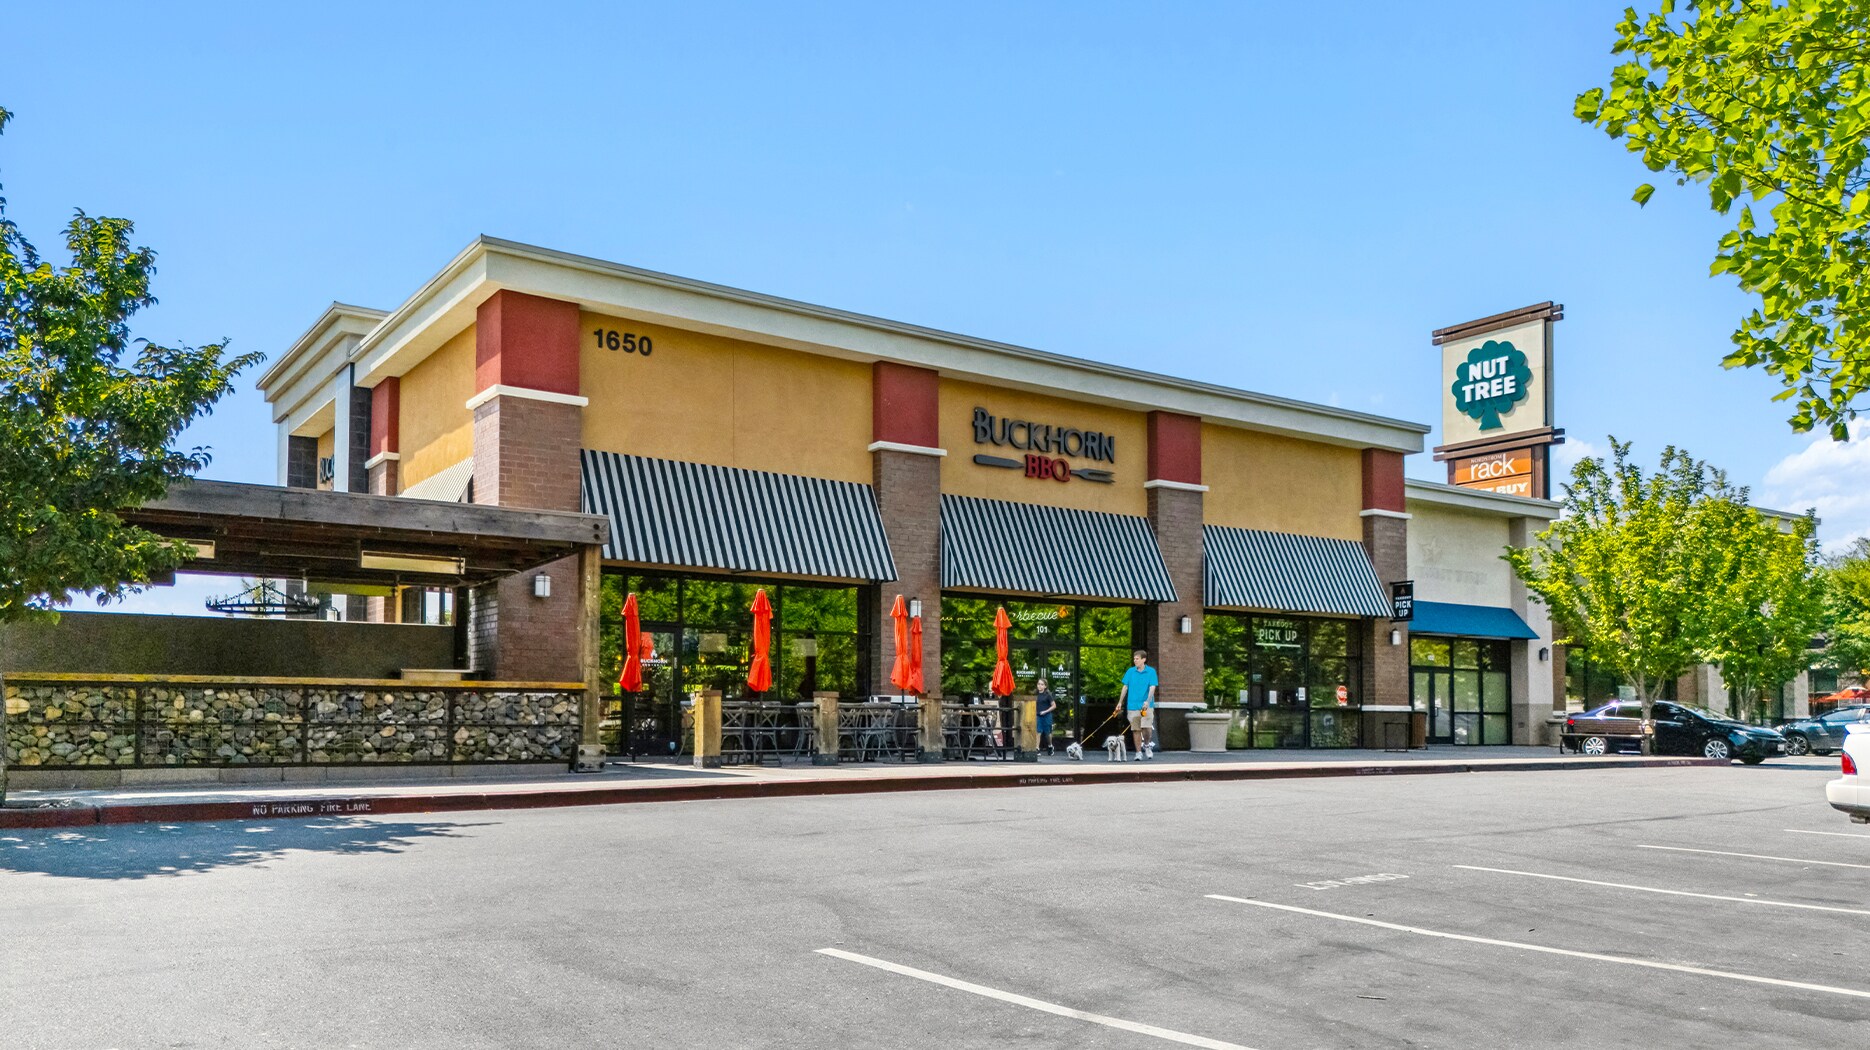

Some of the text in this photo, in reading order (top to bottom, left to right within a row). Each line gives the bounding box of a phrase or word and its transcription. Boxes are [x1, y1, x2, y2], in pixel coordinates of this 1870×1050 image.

[593, 328, 653, 356] 1650
[1468, 355, 1509, 382] NUT
[1461, 375, 1516, 403] TREE
[971, 406, 1115, 464] BUCKHORN
[1024, 453, 1071, 482] BBQ
[1470, 453, 1516, 480] rack
[1496, 482, 1528, 494] BUY
[1395, 600, 1412, 609] PICK
[1012, 608, 1057, 620] rbecue
[1398, 609, 1409, 617] UP
[1036, 625, 1048, 634] 101
[1259, 628, 1298, 642] PICK UP
[252, 802, 372, 815] NO PARKING FIRE LANE
